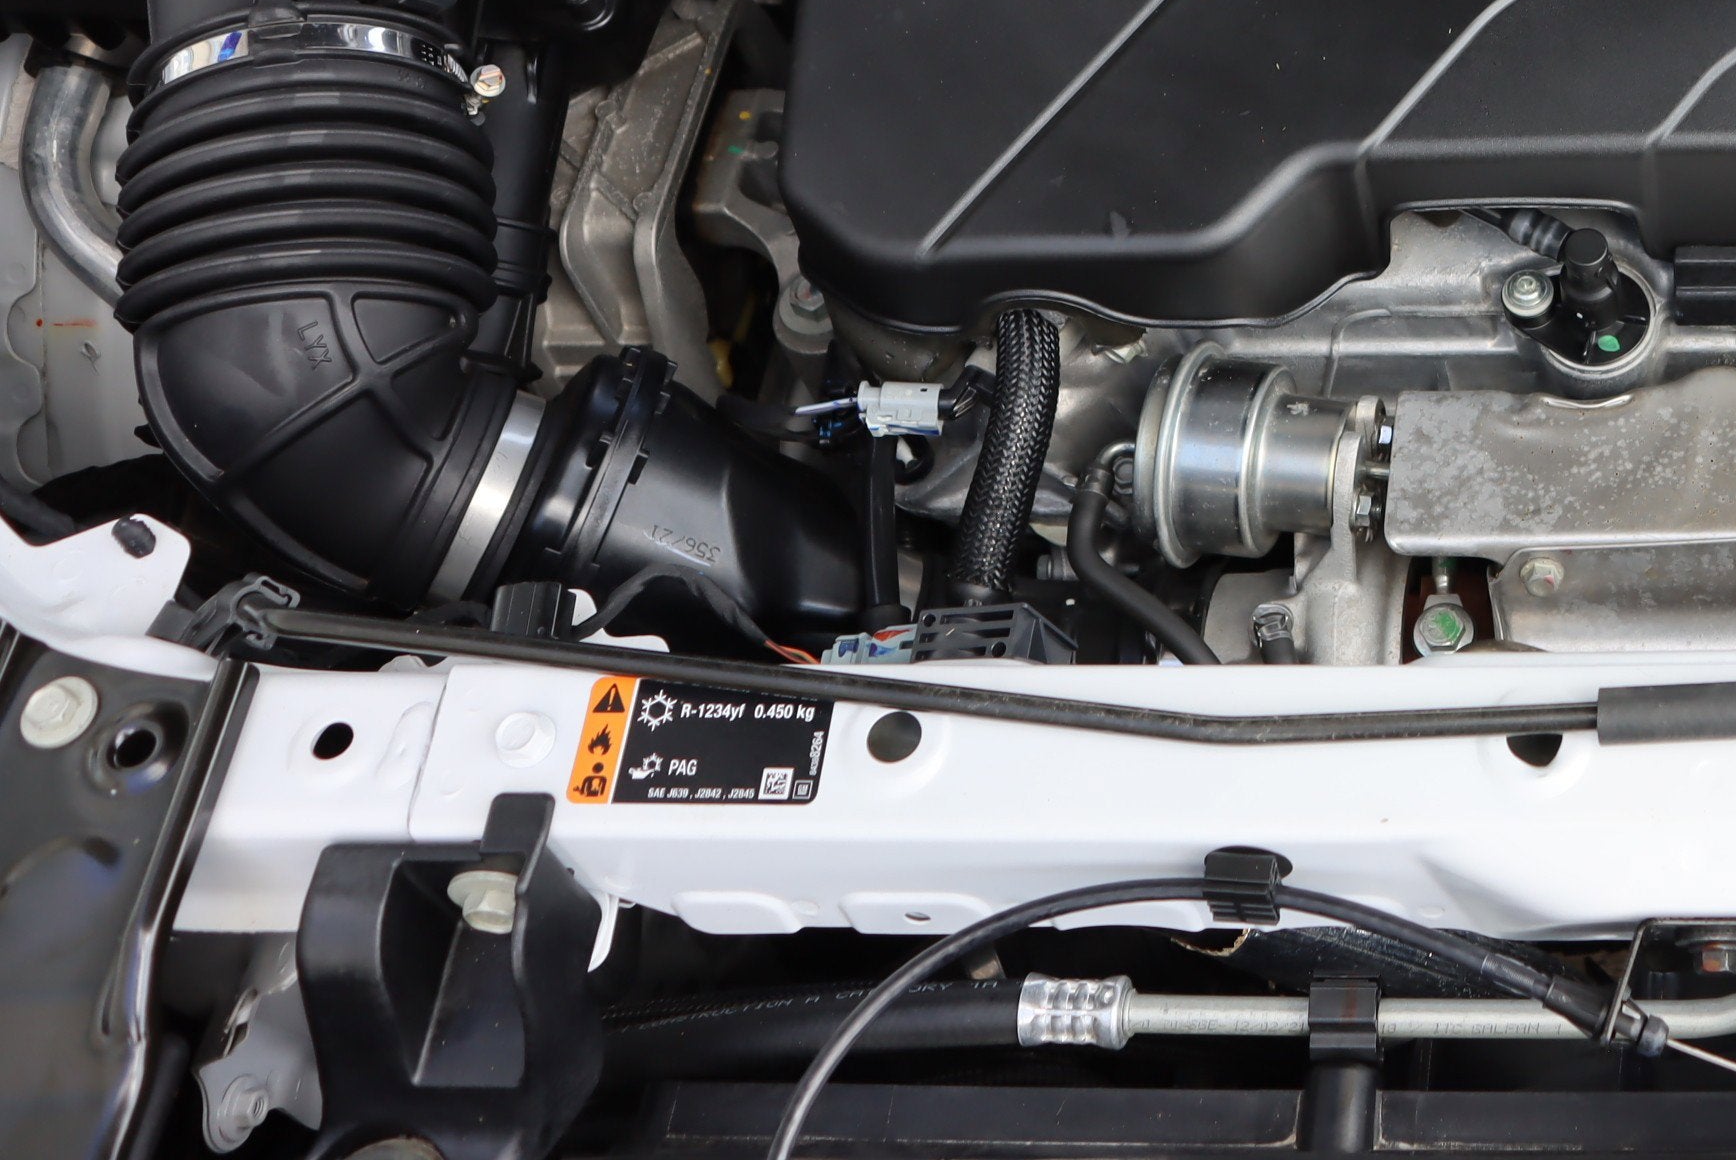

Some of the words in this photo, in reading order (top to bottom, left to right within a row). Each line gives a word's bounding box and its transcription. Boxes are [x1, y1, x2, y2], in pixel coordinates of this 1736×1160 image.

[680, 703, 746, 725] R-1234yf
[754, 704, 794, 720] 0.450
[796, 704, 815, 723] kg
[668, 759, 698, 776] PAG
[647, 787, 665, 799] SAE
